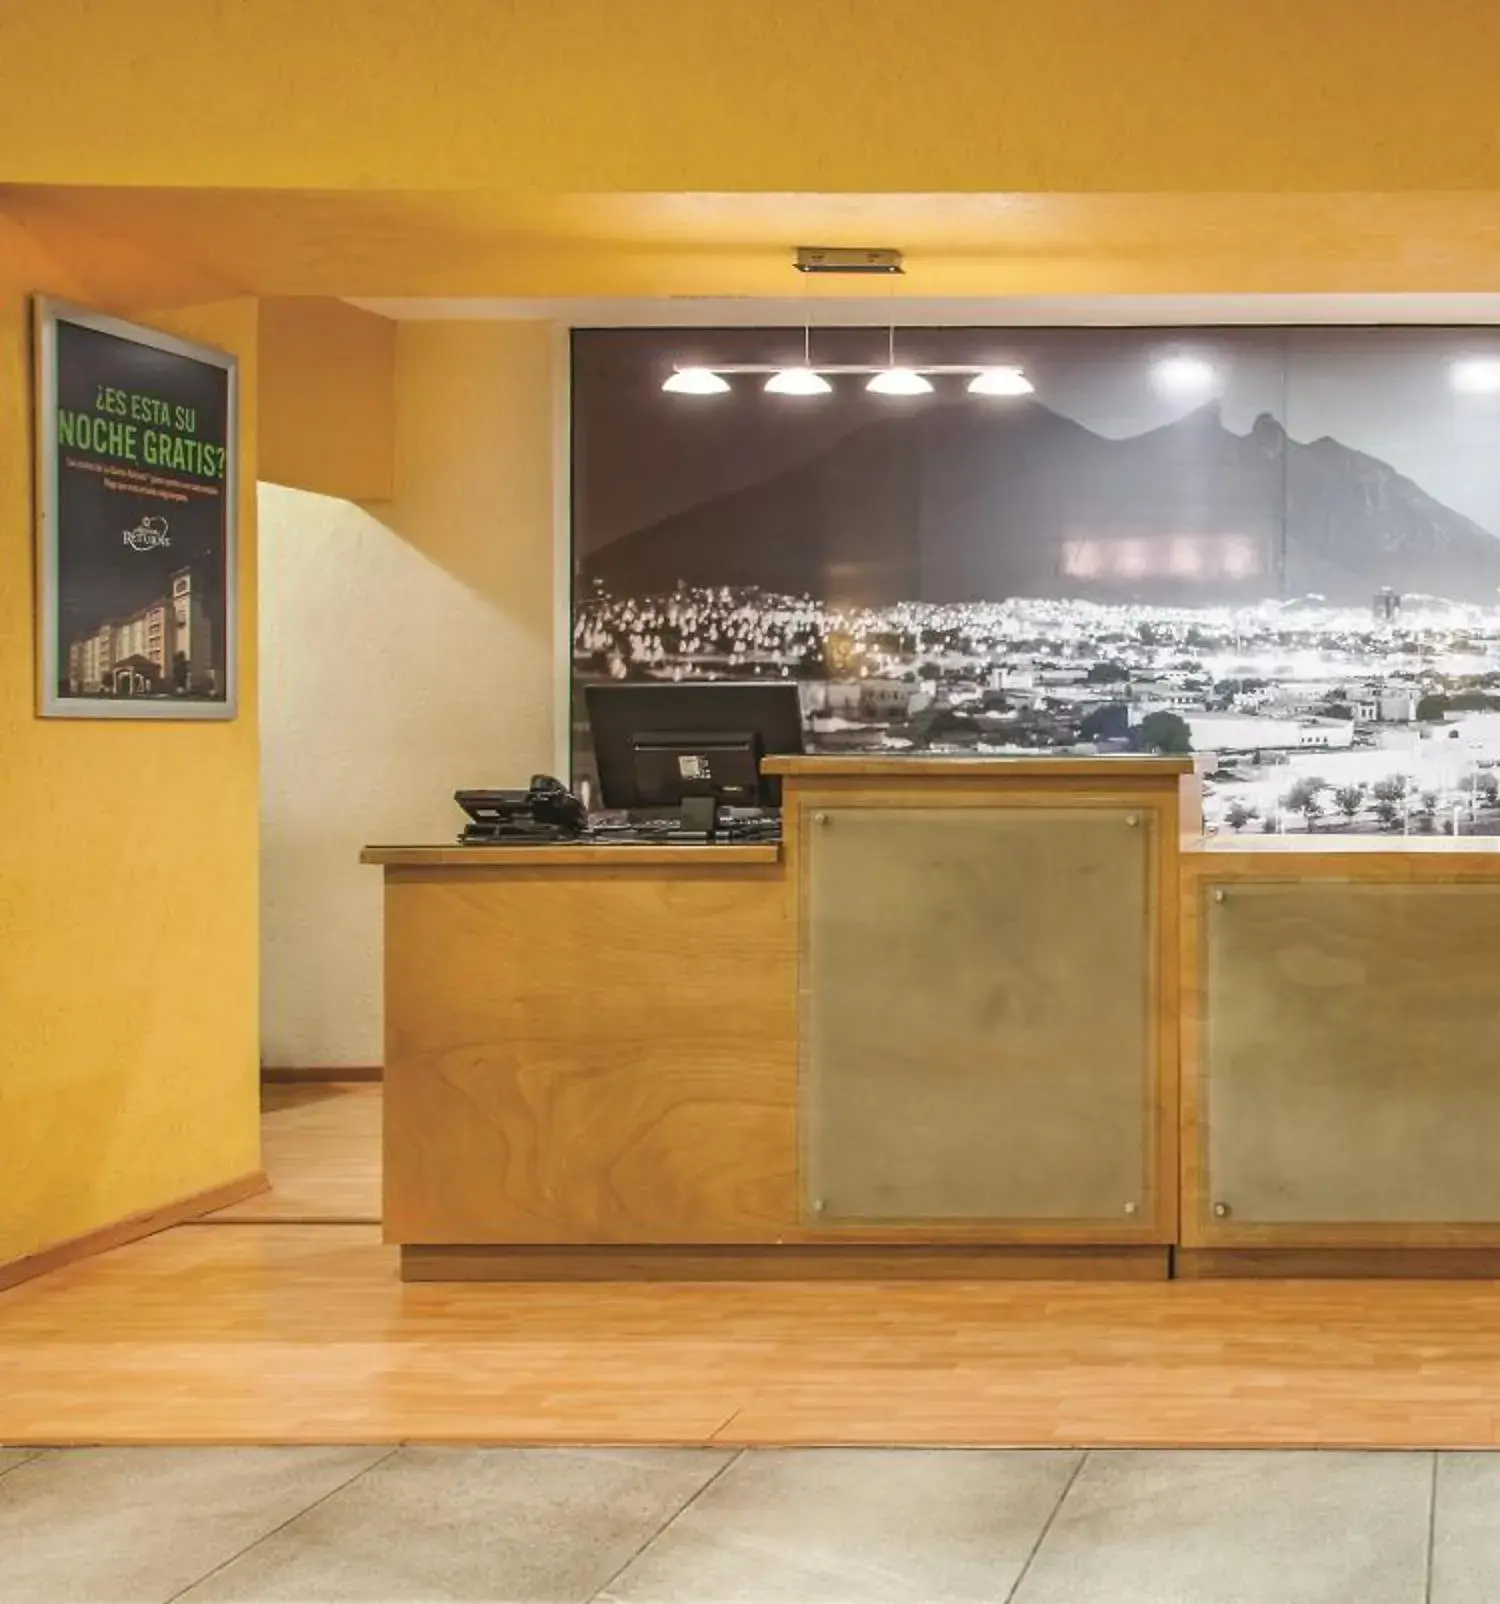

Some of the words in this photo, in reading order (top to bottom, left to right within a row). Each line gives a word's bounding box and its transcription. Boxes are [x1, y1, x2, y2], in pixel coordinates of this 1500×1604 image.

[95, 384, 127, 417] ¿ES
[131, 394, 171, 428] ESTA
[175, 405, 195, 433] SU
[59, 407, 137, 460] NOCHE
[143, 429, 226, 479] GRATIS?
